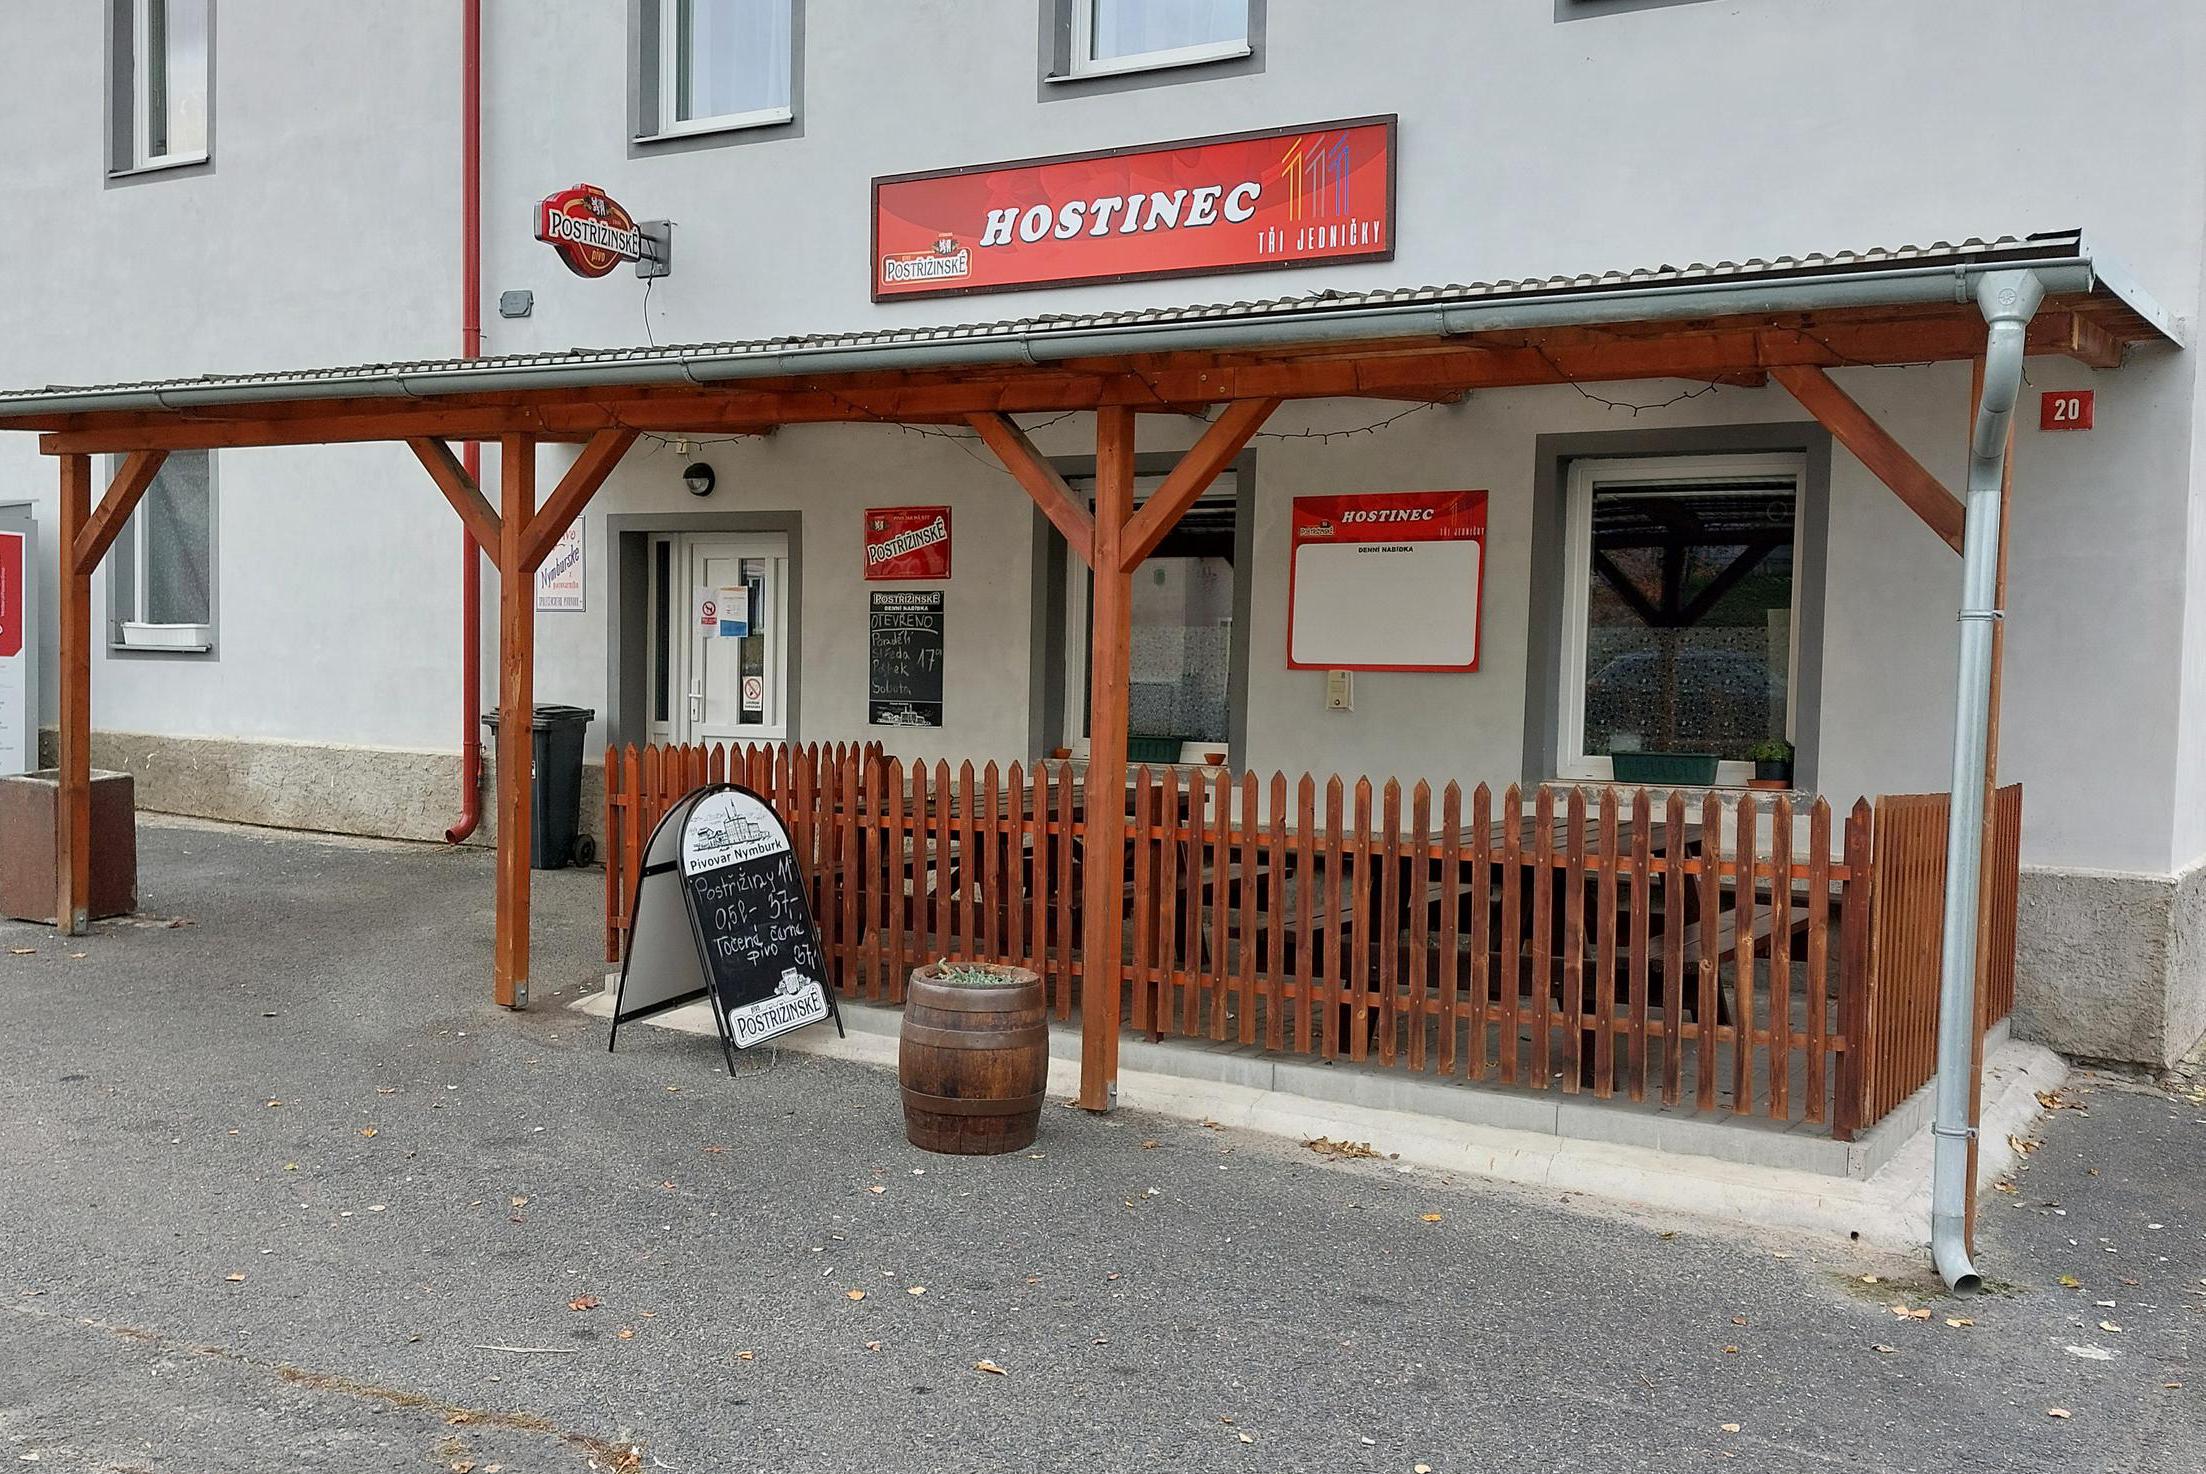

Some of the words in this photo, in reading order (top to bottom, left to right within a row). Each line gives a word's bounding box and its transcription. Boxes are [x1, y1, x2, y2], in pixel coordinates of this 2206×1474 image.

[979, 181, 1262, 247] HOSTINEC
[551, 211, 638, 255] POSTŘIŽINSKÉ
[1258, 226, 1284, 254] TŘI
[1297, 217, 1380, 251] JEDNIČKY
[887, 249, 967, 280] POSTŘIŽINSKÉ
[2054, 398, 2080, 421] 20
[1341, 508, 1435, 524] HOSTINEC
[869, 516, 946, 563] POSTŘIŽINSKÉ
[871, 612, 933, 629] OTEVŘENO
[690, 853, 732, 871] Pivovar
[734, 838, 783, 860] Nymburk
[737, 987, 821, 1039] POSTŘIŽINSKÉ
